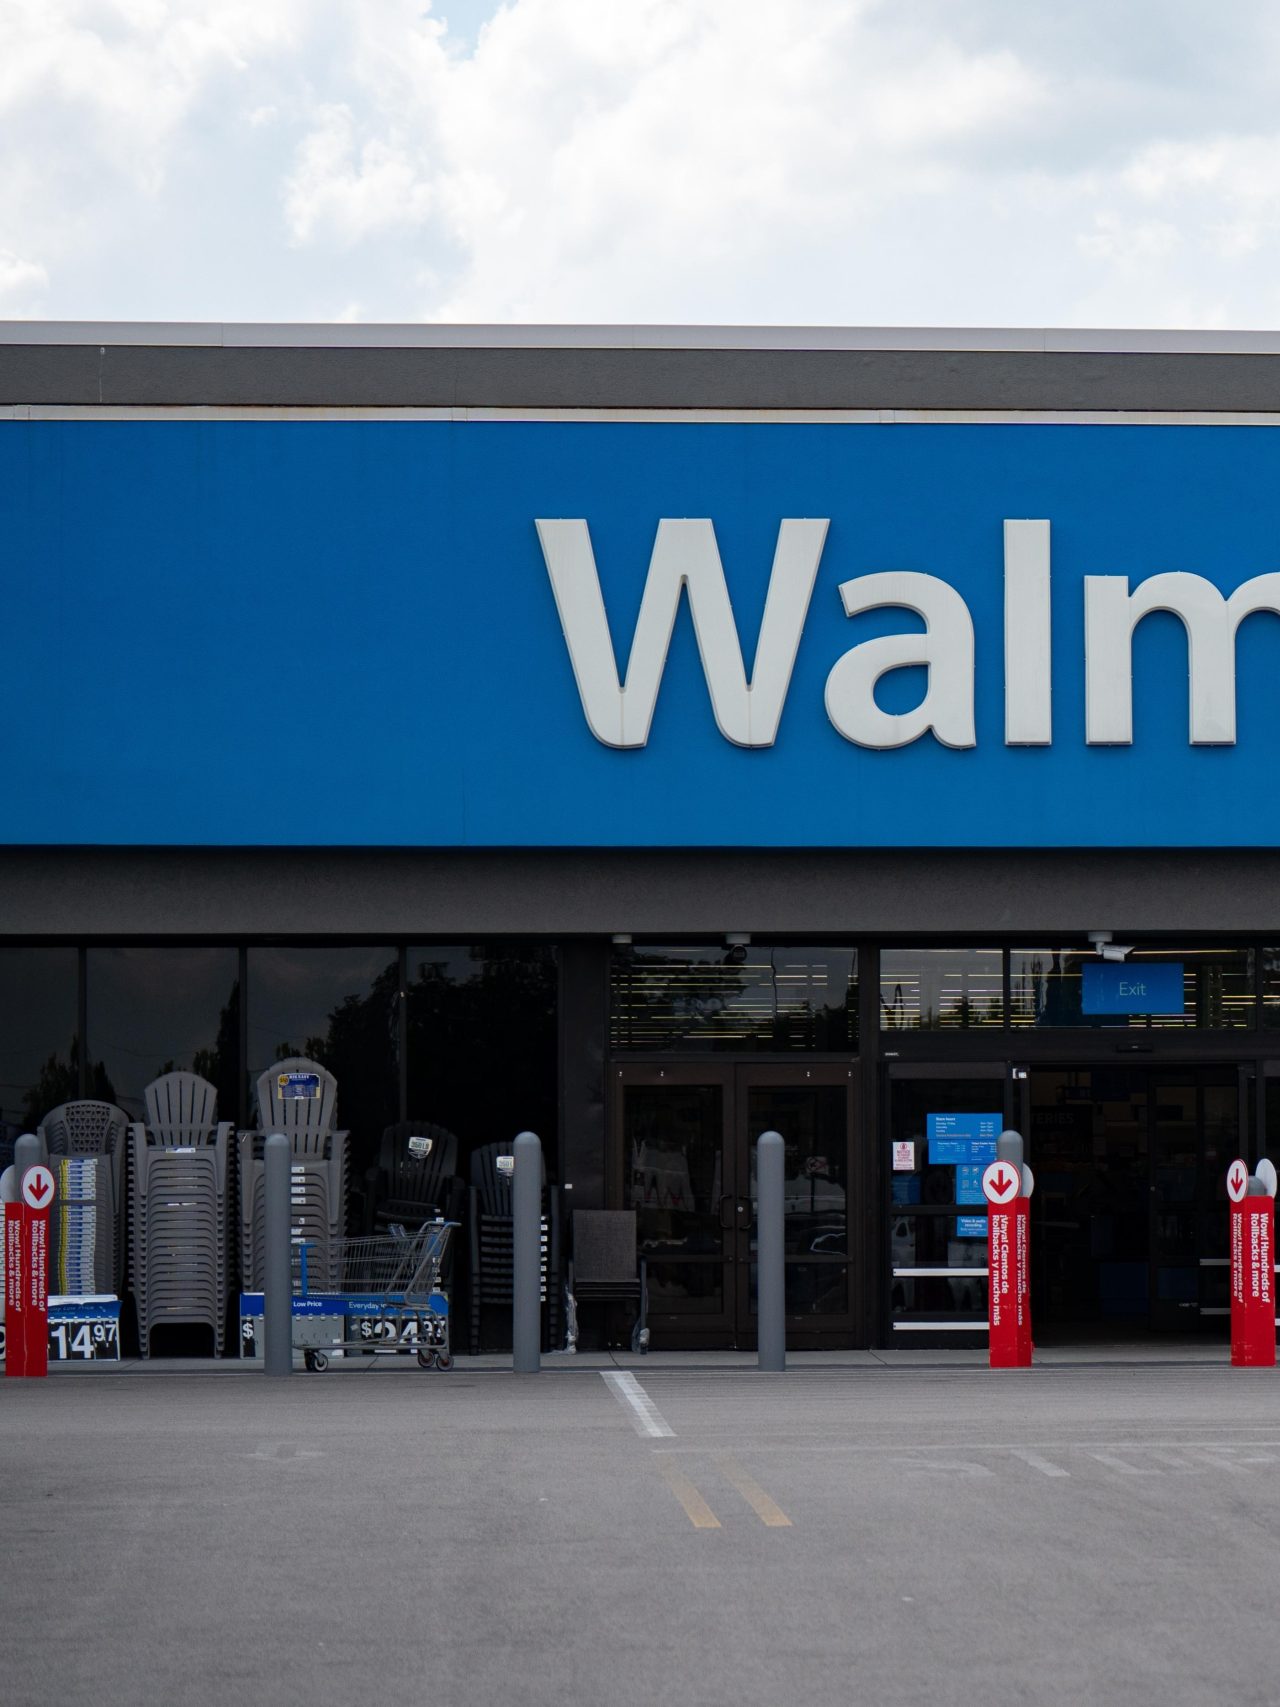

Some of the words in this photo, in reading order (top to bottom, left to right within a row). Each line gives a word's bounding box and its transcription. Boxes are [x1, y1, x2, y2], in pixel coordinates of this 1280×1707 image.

[1120, 982, 1147, 996] Exit
[1261, 1213, 1269, 1240] Wow!
[992, 1215, 1000, 1260] Rollbacks
[1251, 1213, 1259, 1260] Rollbacks
[1001, 1244, 1009, 1280] Cientos
[1261, 1241, 1270, 1290] Hundreds
[1001, 1281, 1009, 1294] de
[349, 1301, 379, 1310] Everyday
[1262, 1291, 1270, 1303] of
[16, 1300, 22, 1312] of
[39, 1300, 46, 1312] of
[993, 1306, 1001, 1326] más
[242, 1322, 254, 1339] $
